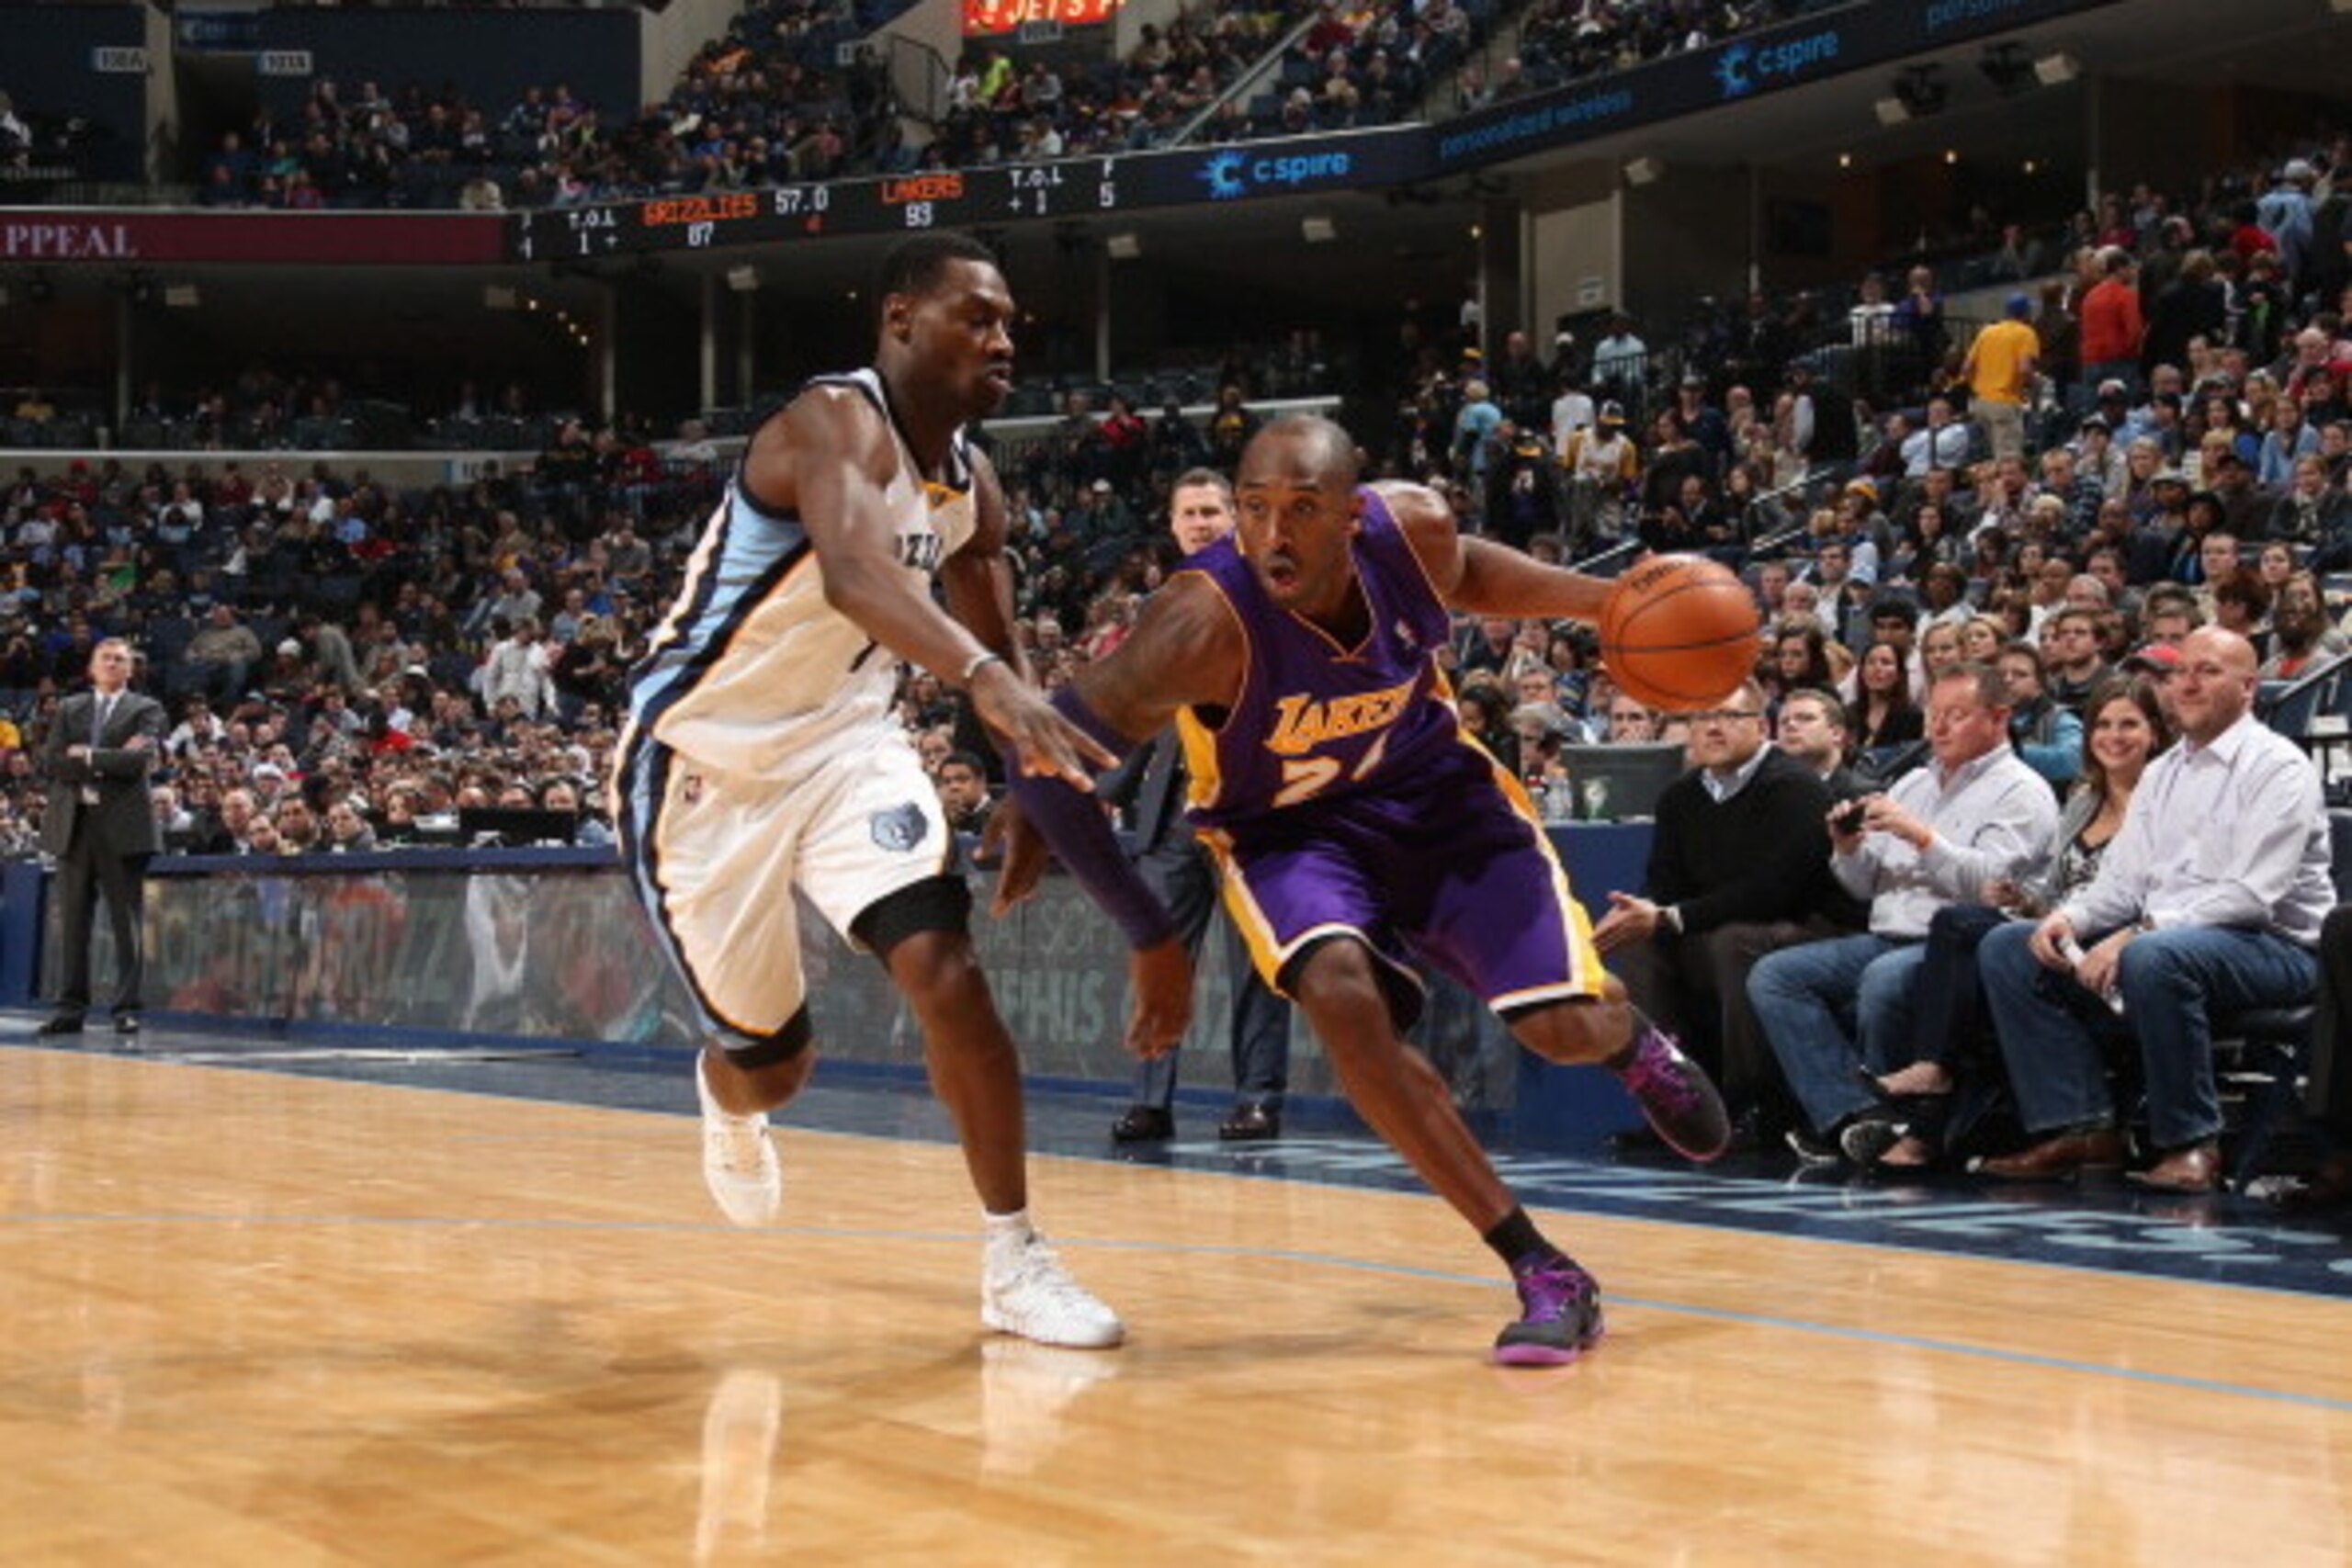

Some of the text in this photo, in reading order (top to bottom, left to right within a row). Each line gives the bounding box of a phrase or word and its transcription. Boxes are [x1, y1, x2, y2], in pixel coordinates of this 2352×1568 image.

[775, 186, 829, 215] 57.0
[882, 173, 964, 204] LAKERS
[642, 193, 759, 225] GRIZZLIES
[6, 223, 138, 259] PPEAL
